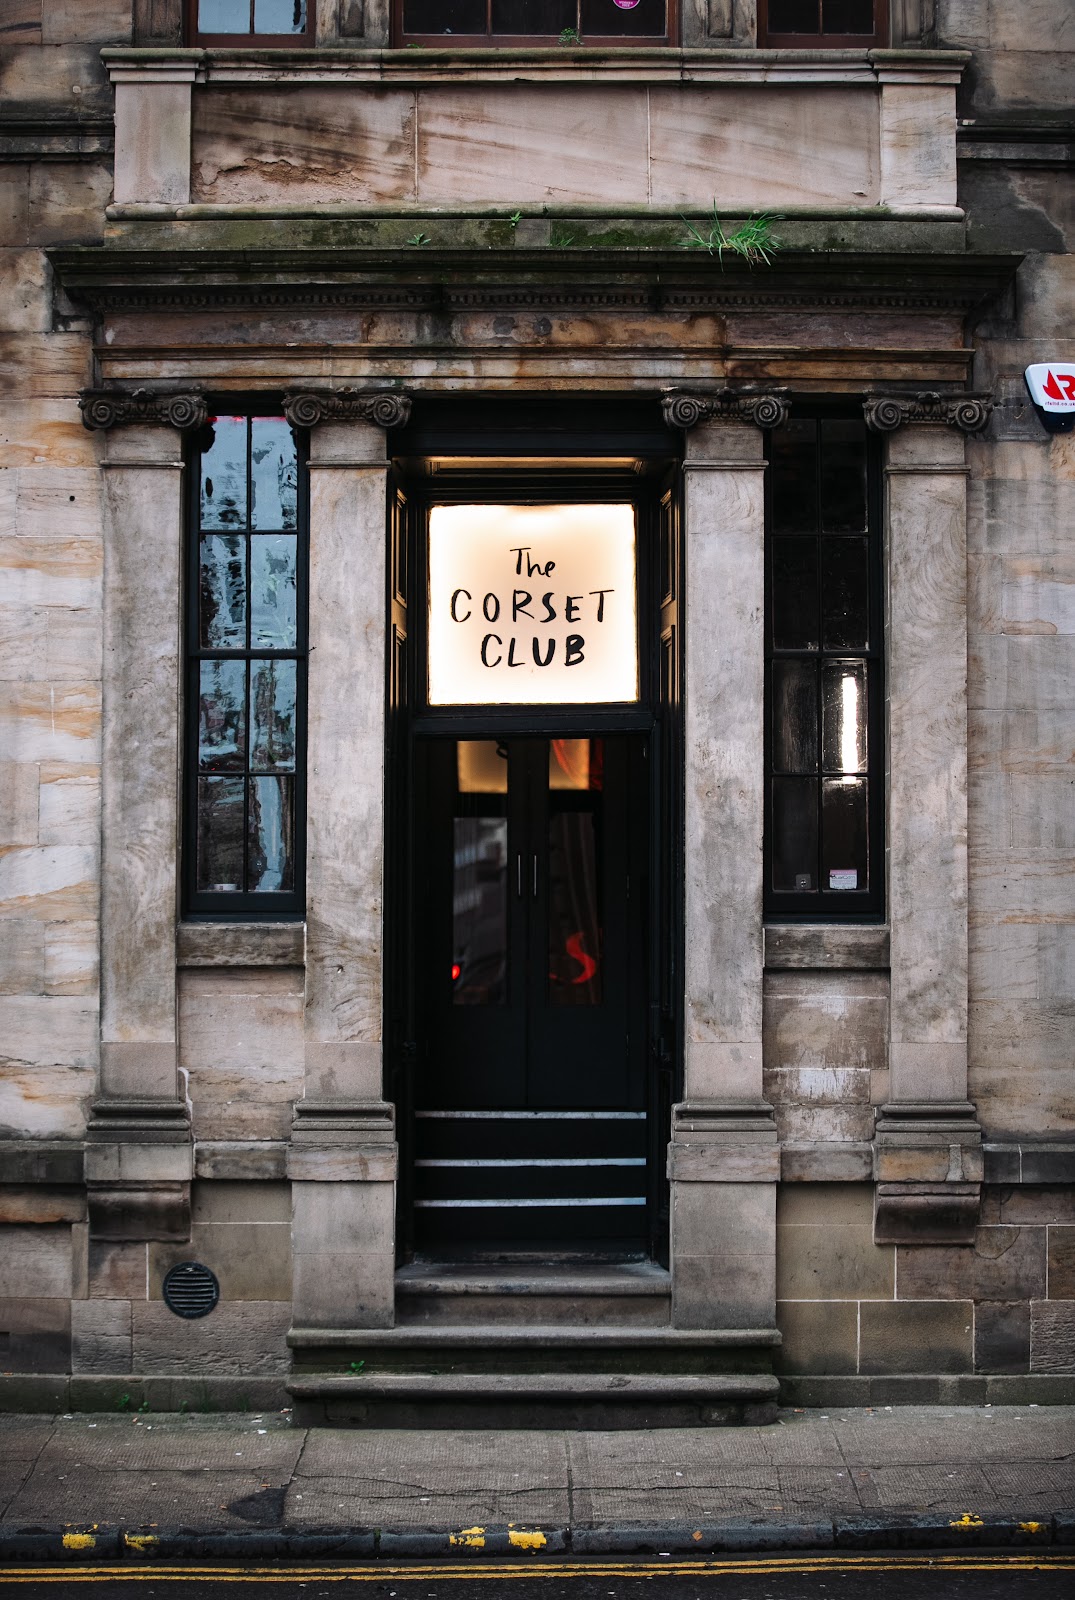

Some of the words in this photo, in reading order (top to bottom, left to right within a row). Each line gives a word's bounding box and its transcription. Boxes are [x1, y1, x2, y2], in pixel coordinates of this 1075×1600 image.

[509, 547, 556, 577] The
[451, 588, 615, 622] CORSET
[480, 633, 585, 667] CLUB
